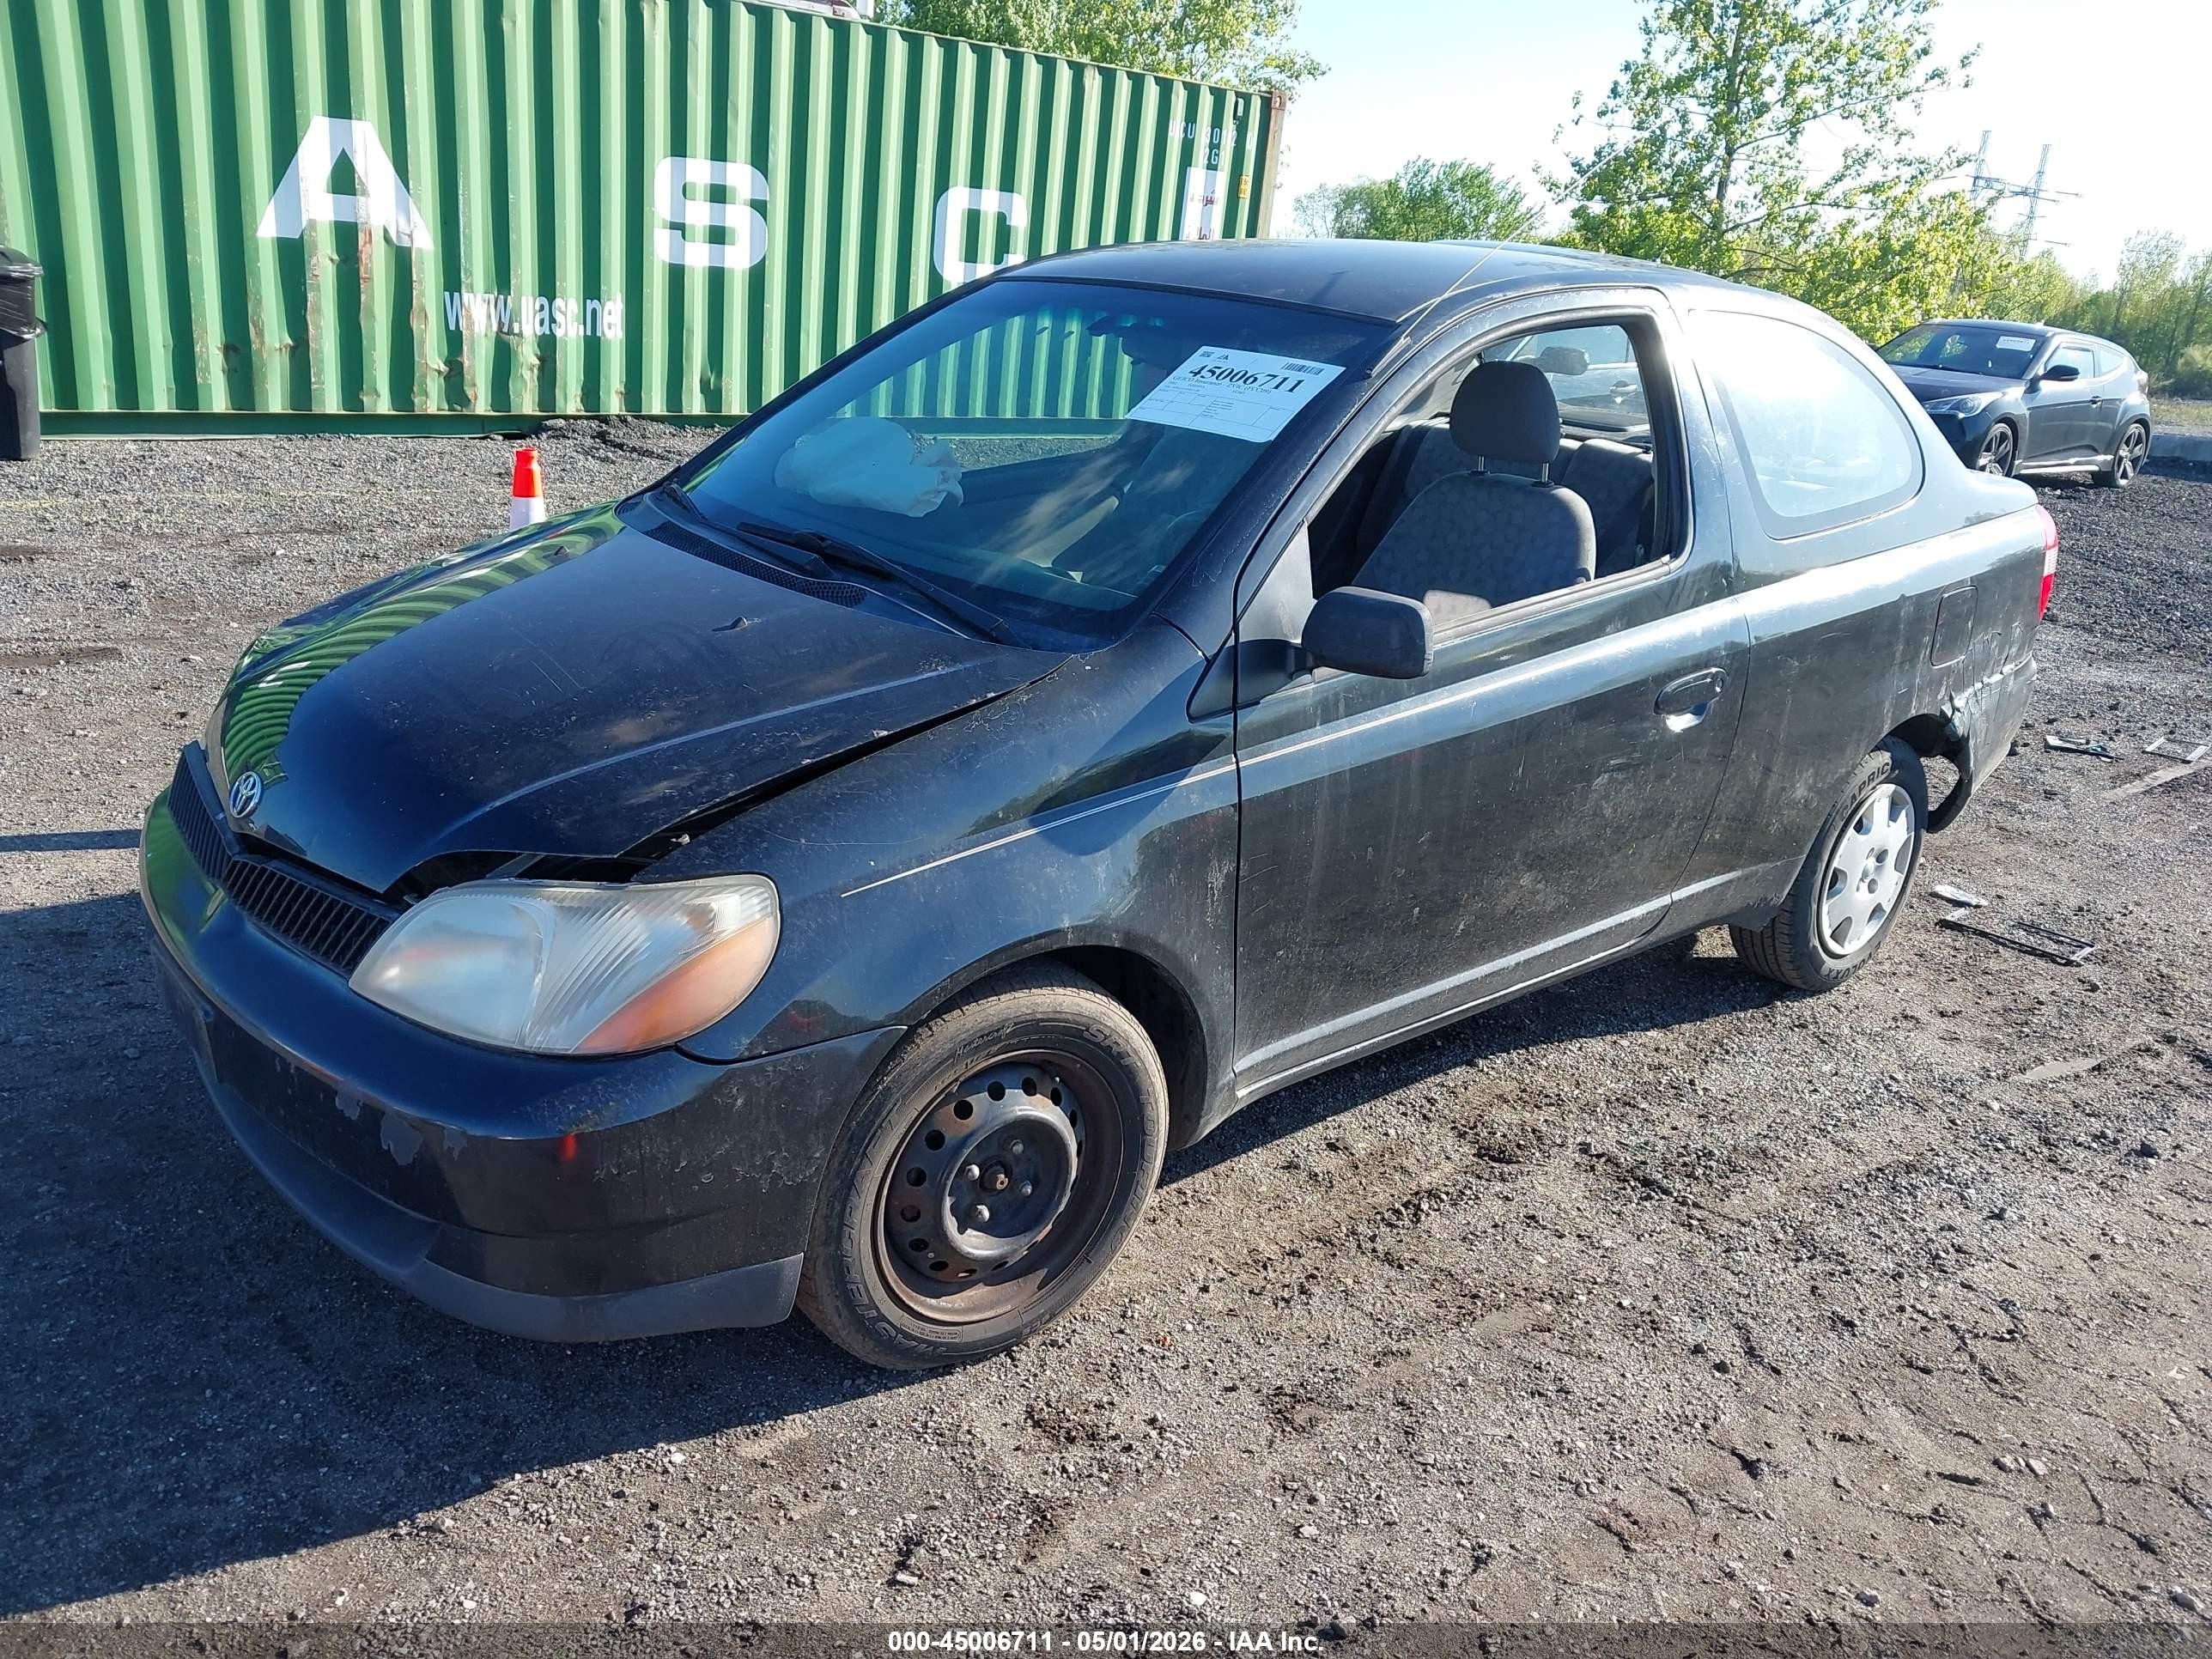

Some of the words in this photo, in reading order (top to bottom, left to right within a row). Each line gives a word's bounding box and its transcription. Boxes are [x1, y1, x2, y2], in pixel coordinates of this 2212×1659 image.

[258, 115, 434, 250] A
[653, 155, 769, 270] S
[443, 290, 623, 339] www.uasc.net
[1188, 363, 1304, 393] 45006711
[1082, 1024, 1140, 1070] SRT
